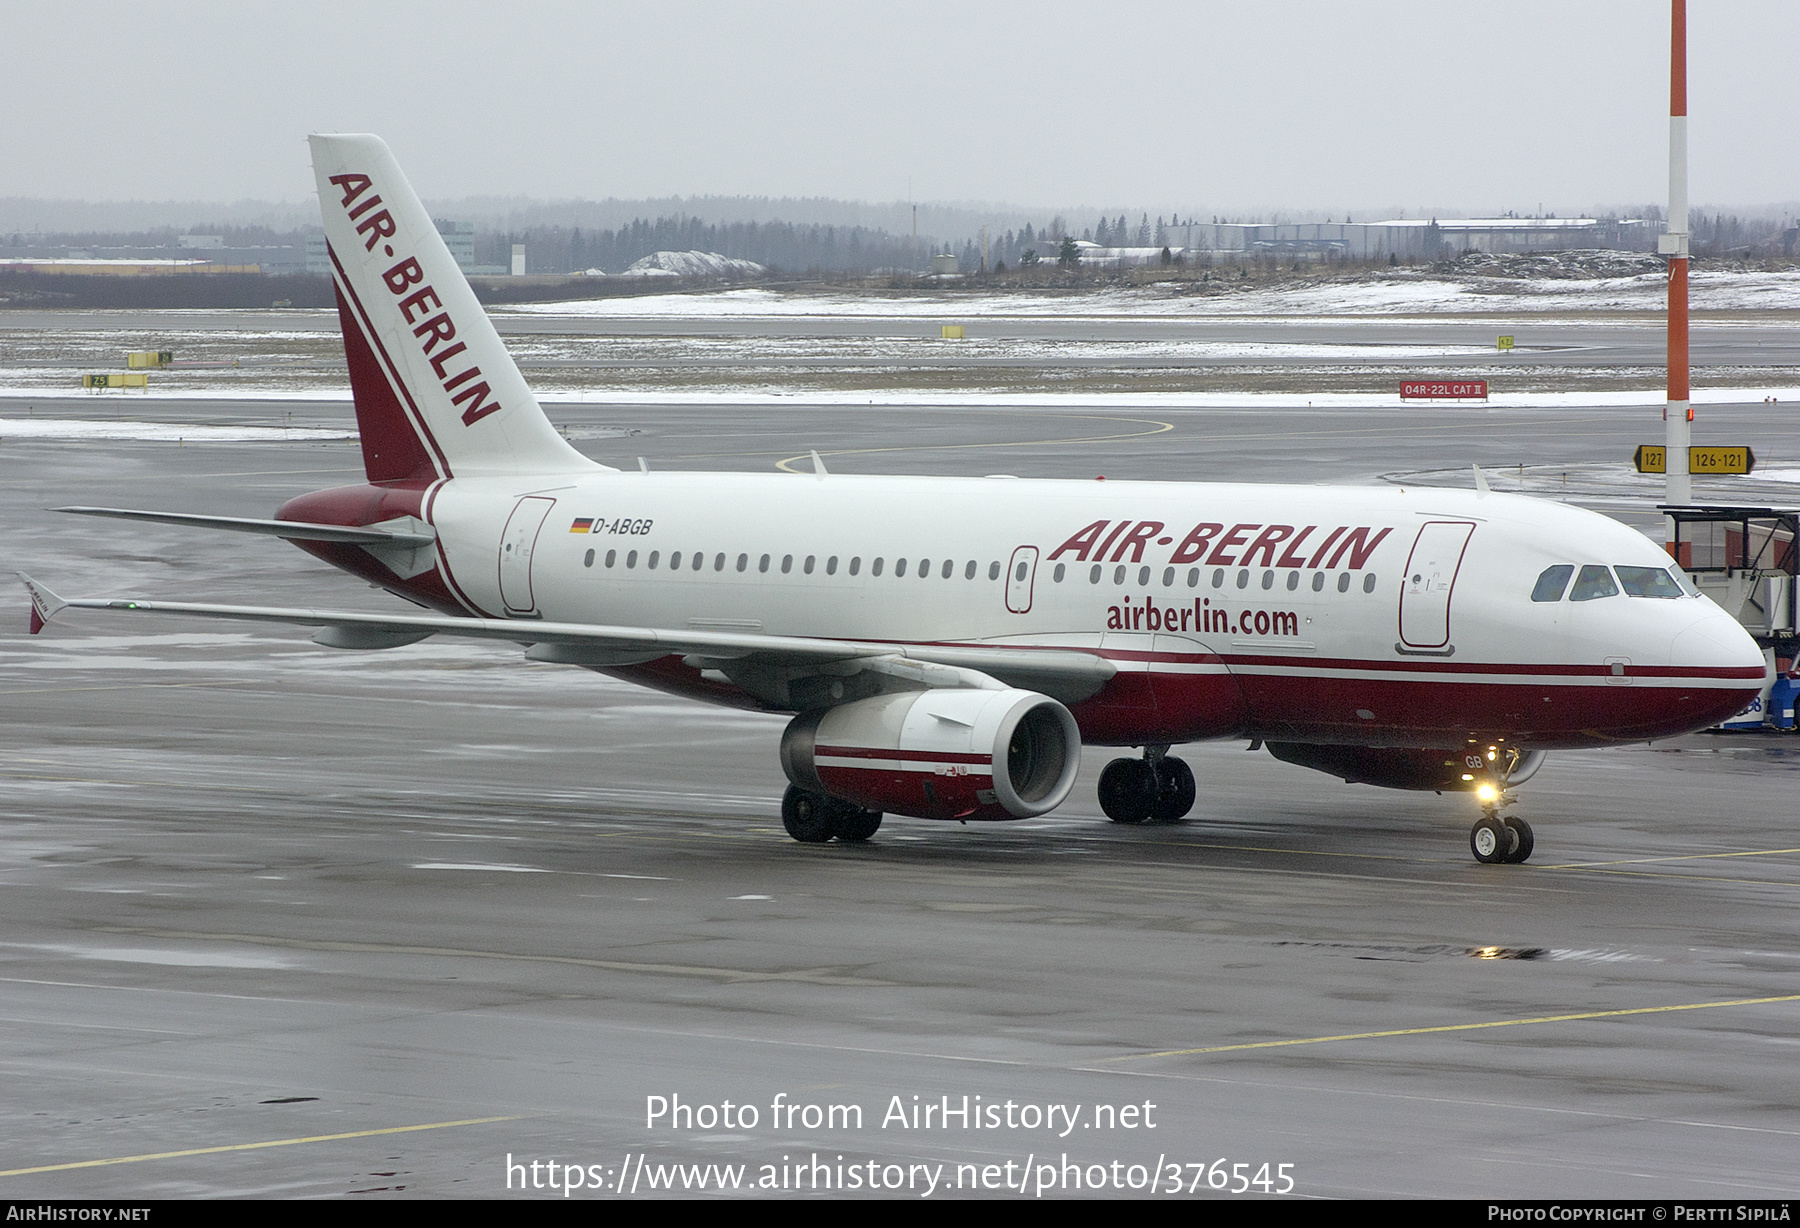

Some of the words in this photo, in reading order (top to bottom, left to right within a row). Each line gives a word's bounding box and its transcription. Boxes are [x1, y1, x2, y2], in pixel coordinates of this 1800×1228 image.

[93, 376, 106, 385] Z5
[1405, 384, 1450, 395] 04R-22L
[1452, 384, 1472, 395] CAT
[1645, 452, 1662, 467] 127
[1695, 453, 1741, 467] 126-121
[591, 517, 654, 537] D-ABGB
[1107, 595, 1299, 636] airberlin.com
[1465, 755, 1484, 769] GB
